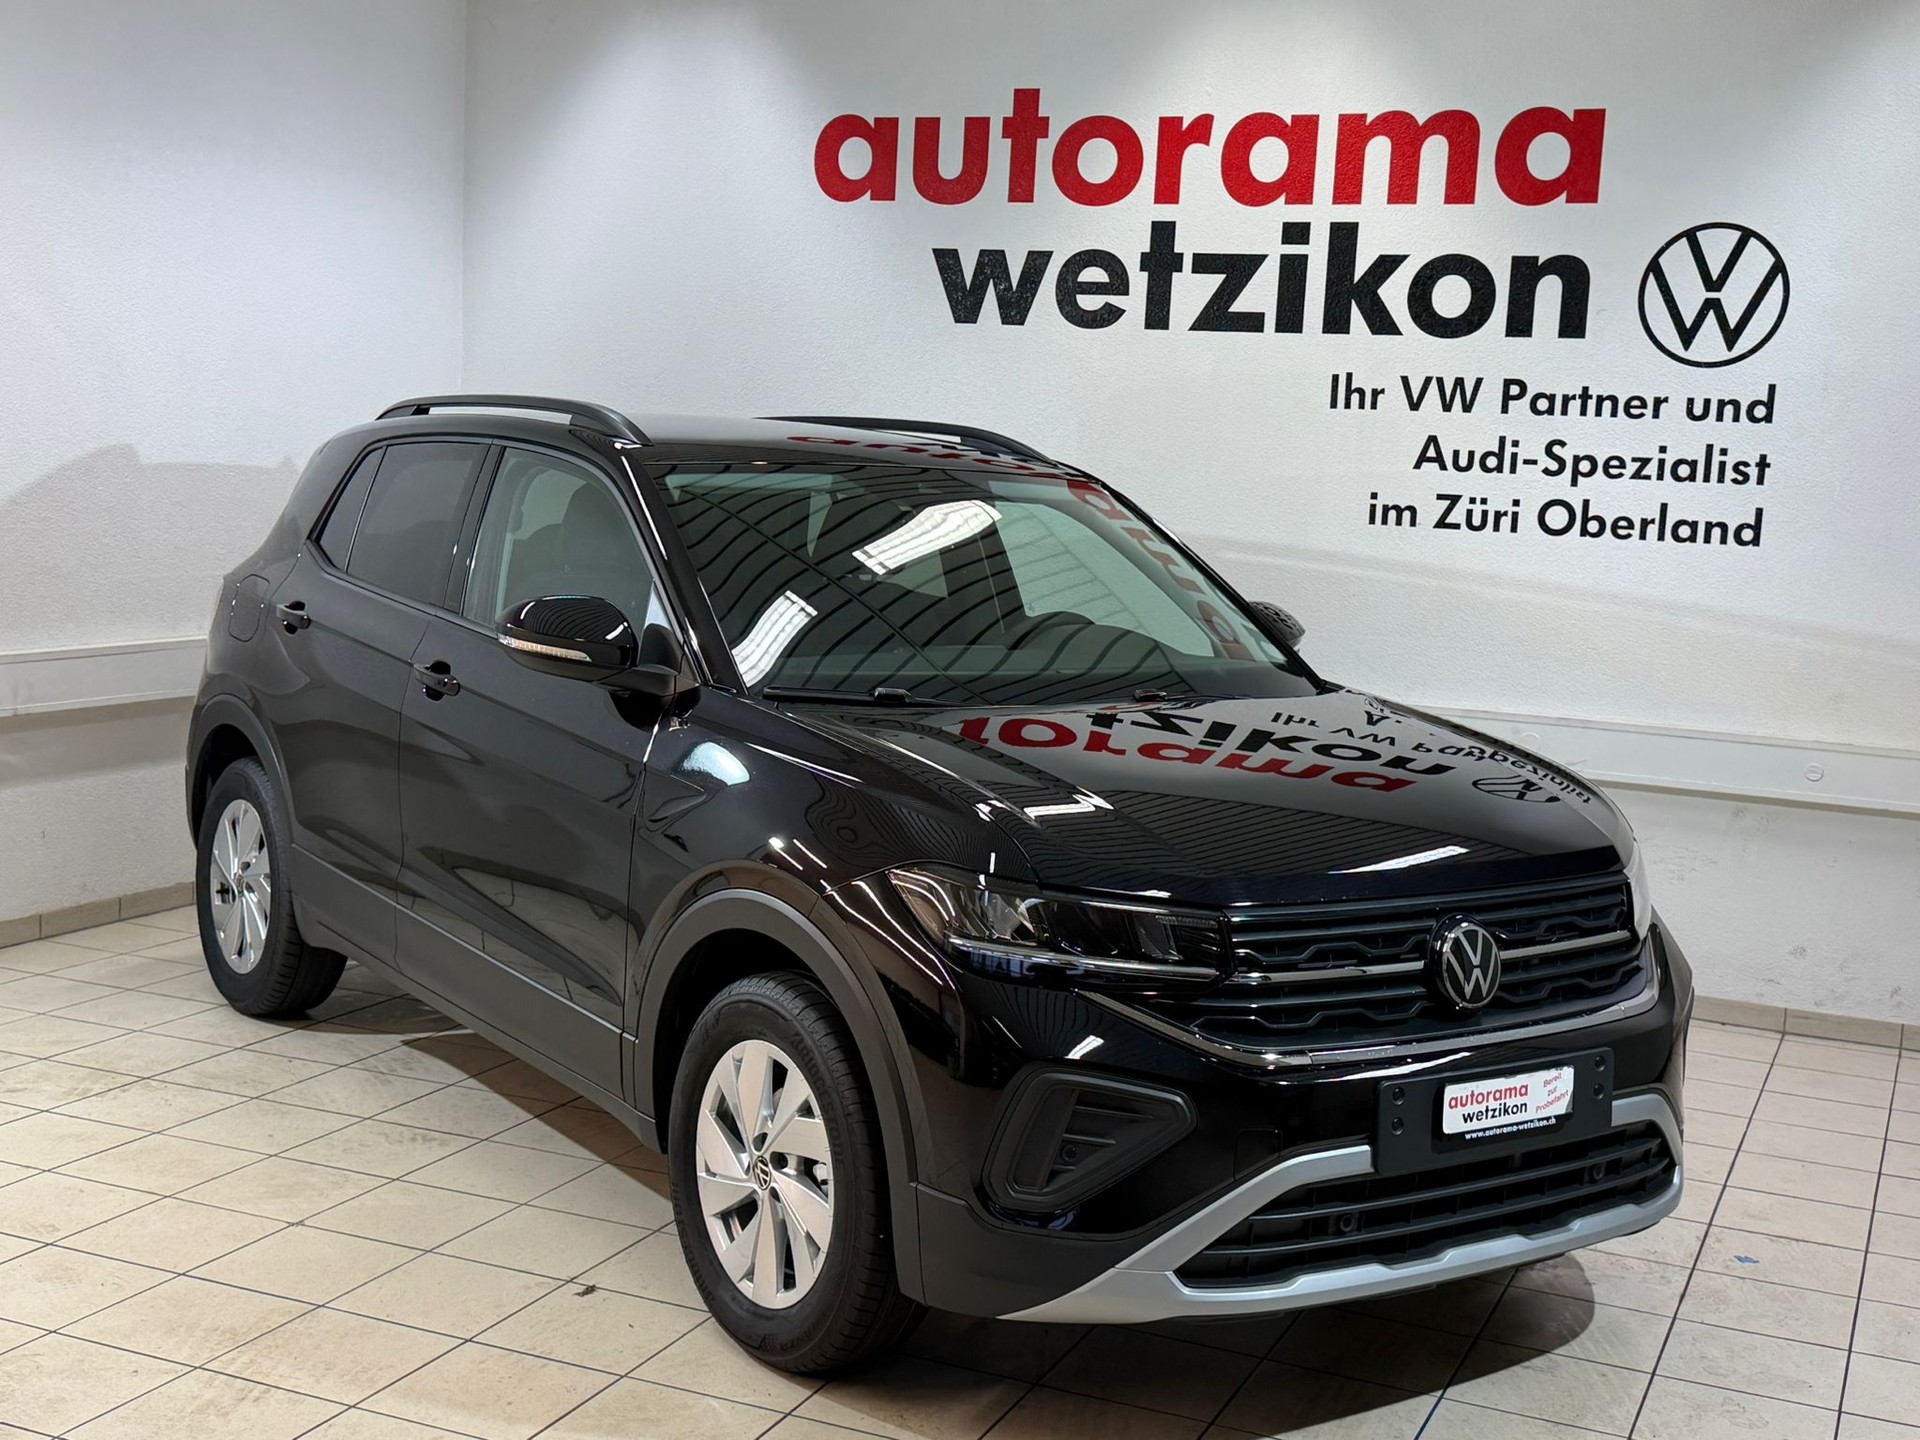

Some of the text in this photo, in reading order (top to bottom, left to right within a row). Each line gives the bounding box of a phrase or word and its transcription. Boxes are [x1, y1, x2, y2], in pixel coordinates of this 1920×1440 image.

[815, 89, 1606, 207] autorama
[932, 221, 1591, 339] wetzikon
[1329, 371, 1777, 424] Ihr VW Partner und
[1412, 434, 1771, 488] Audi-Spezialist
[1368, 491, 1764, 547] im Züri Oberland
[1448, 1084, 1529, 1110] autorama
[1543, 1072, 1562, 1088] Bereit
[1547, 1086, 1558, 1097] zur
[1462, 1102, 1528, 1124] wetzikon
